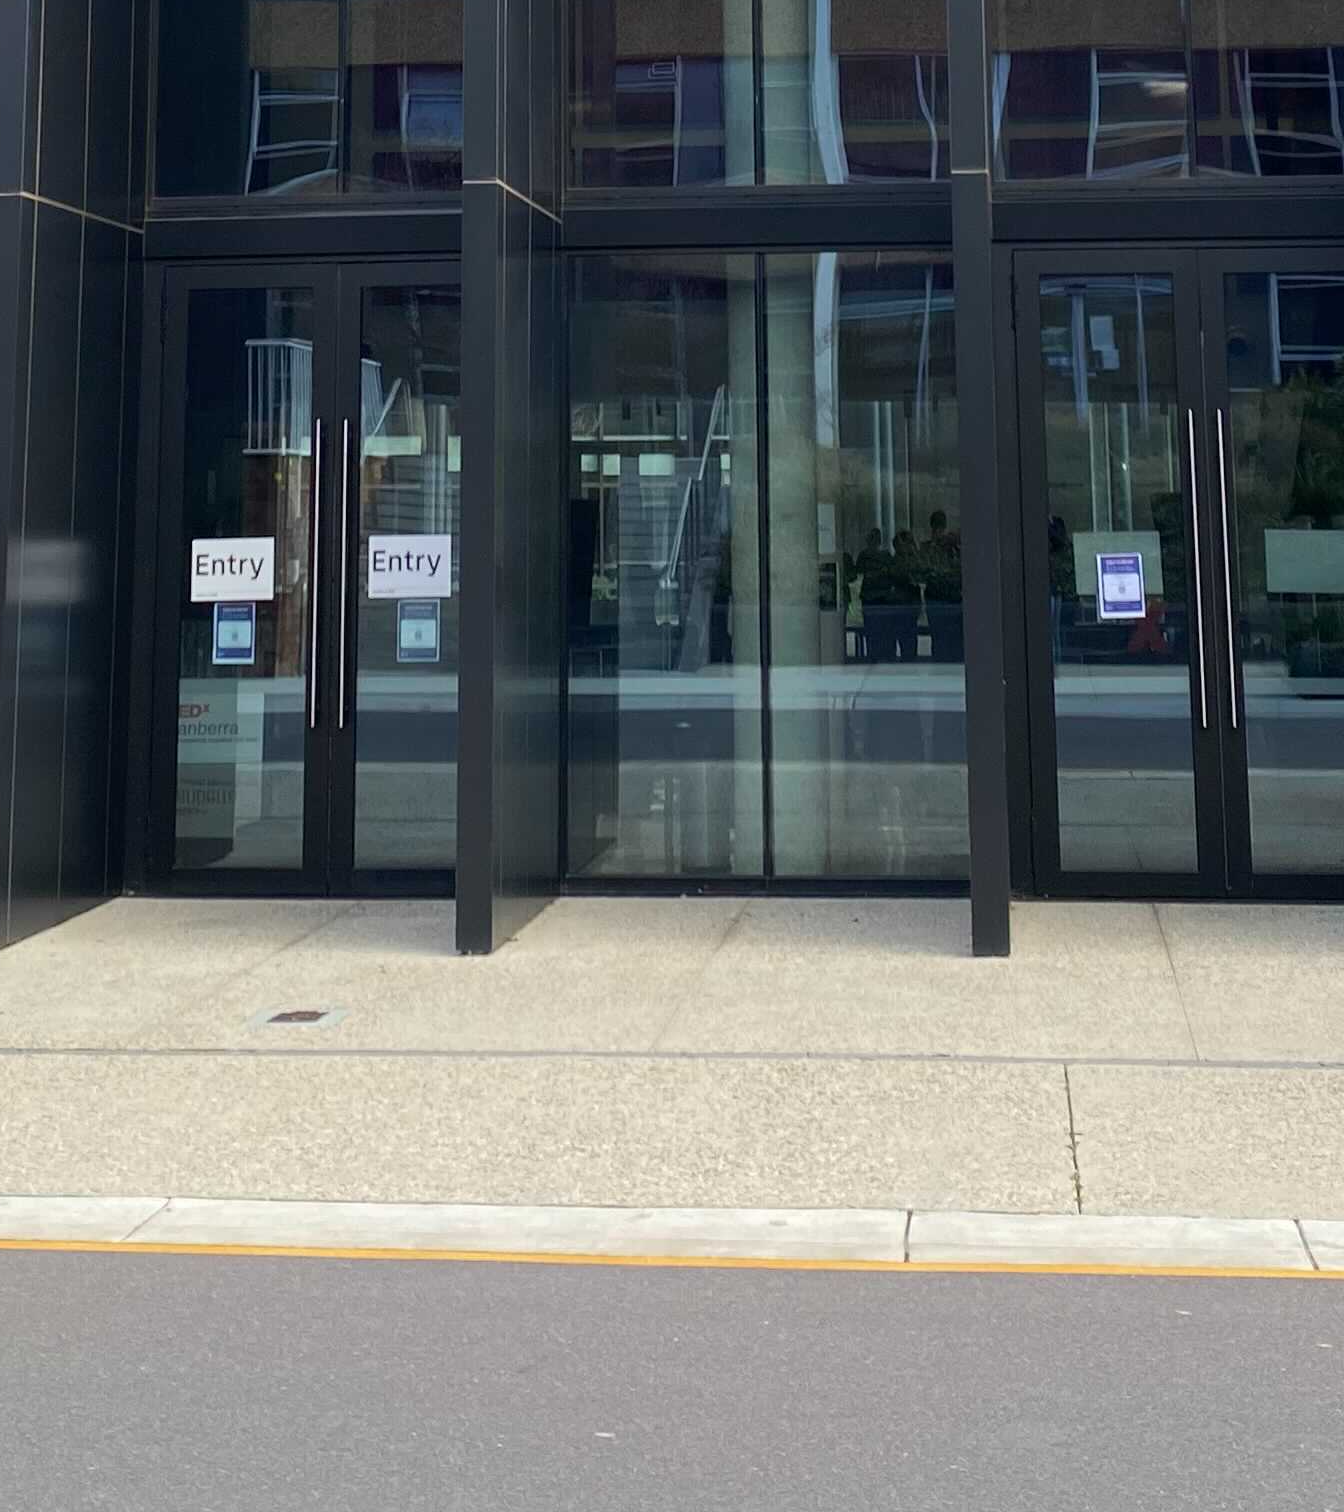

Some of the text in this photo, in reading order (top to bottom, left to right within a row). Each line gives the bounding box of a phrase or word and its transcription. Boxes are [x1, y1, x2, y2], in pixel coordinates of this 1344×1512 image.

[195, 554, 264, 580] Entry
[372, 550, 441, 577] Entry
[178, 703, 210, 719] EDx
[178, 722, 239, 736] anberra
